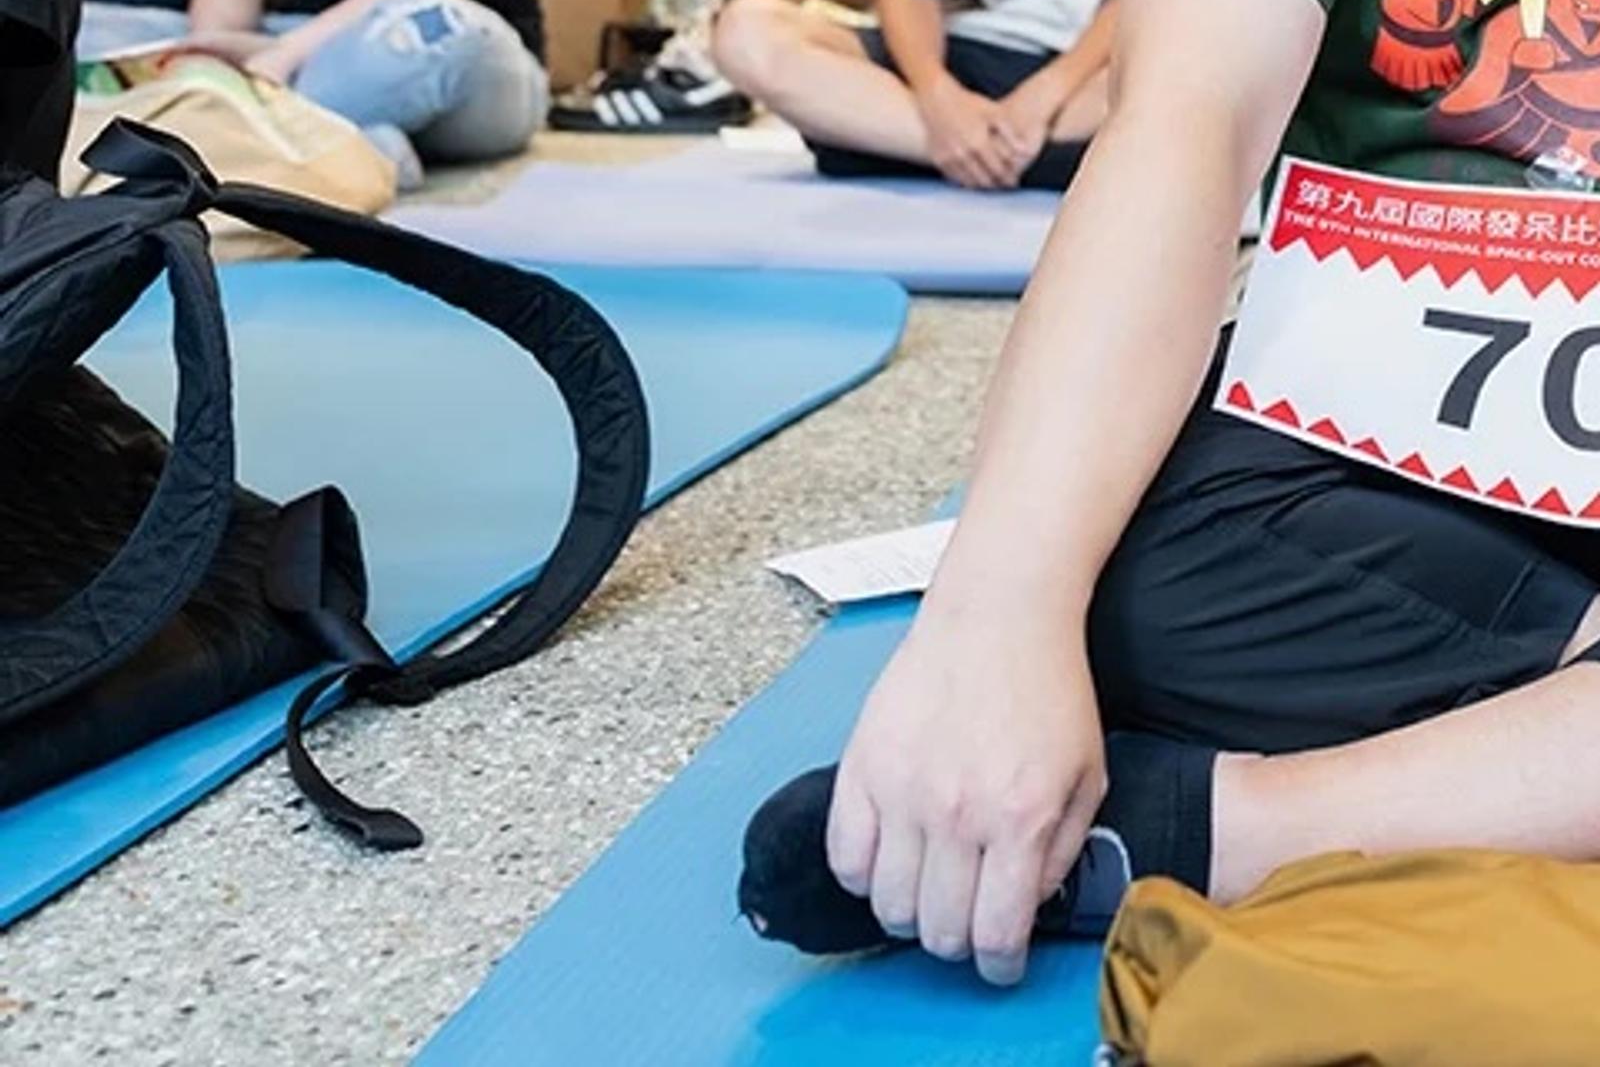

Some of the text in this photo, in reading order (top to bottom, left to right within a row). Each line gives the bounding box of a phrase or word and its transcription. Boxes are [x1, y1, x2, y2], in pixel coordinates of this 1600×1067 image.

[1284, 209, 1316, 228] THE
[1318, 219, 1351, 236] 9TH
[1353, 226, 1481, 257] INTERNATIONAL
[1486, 245, 1577, 265] SPACE-OUT
